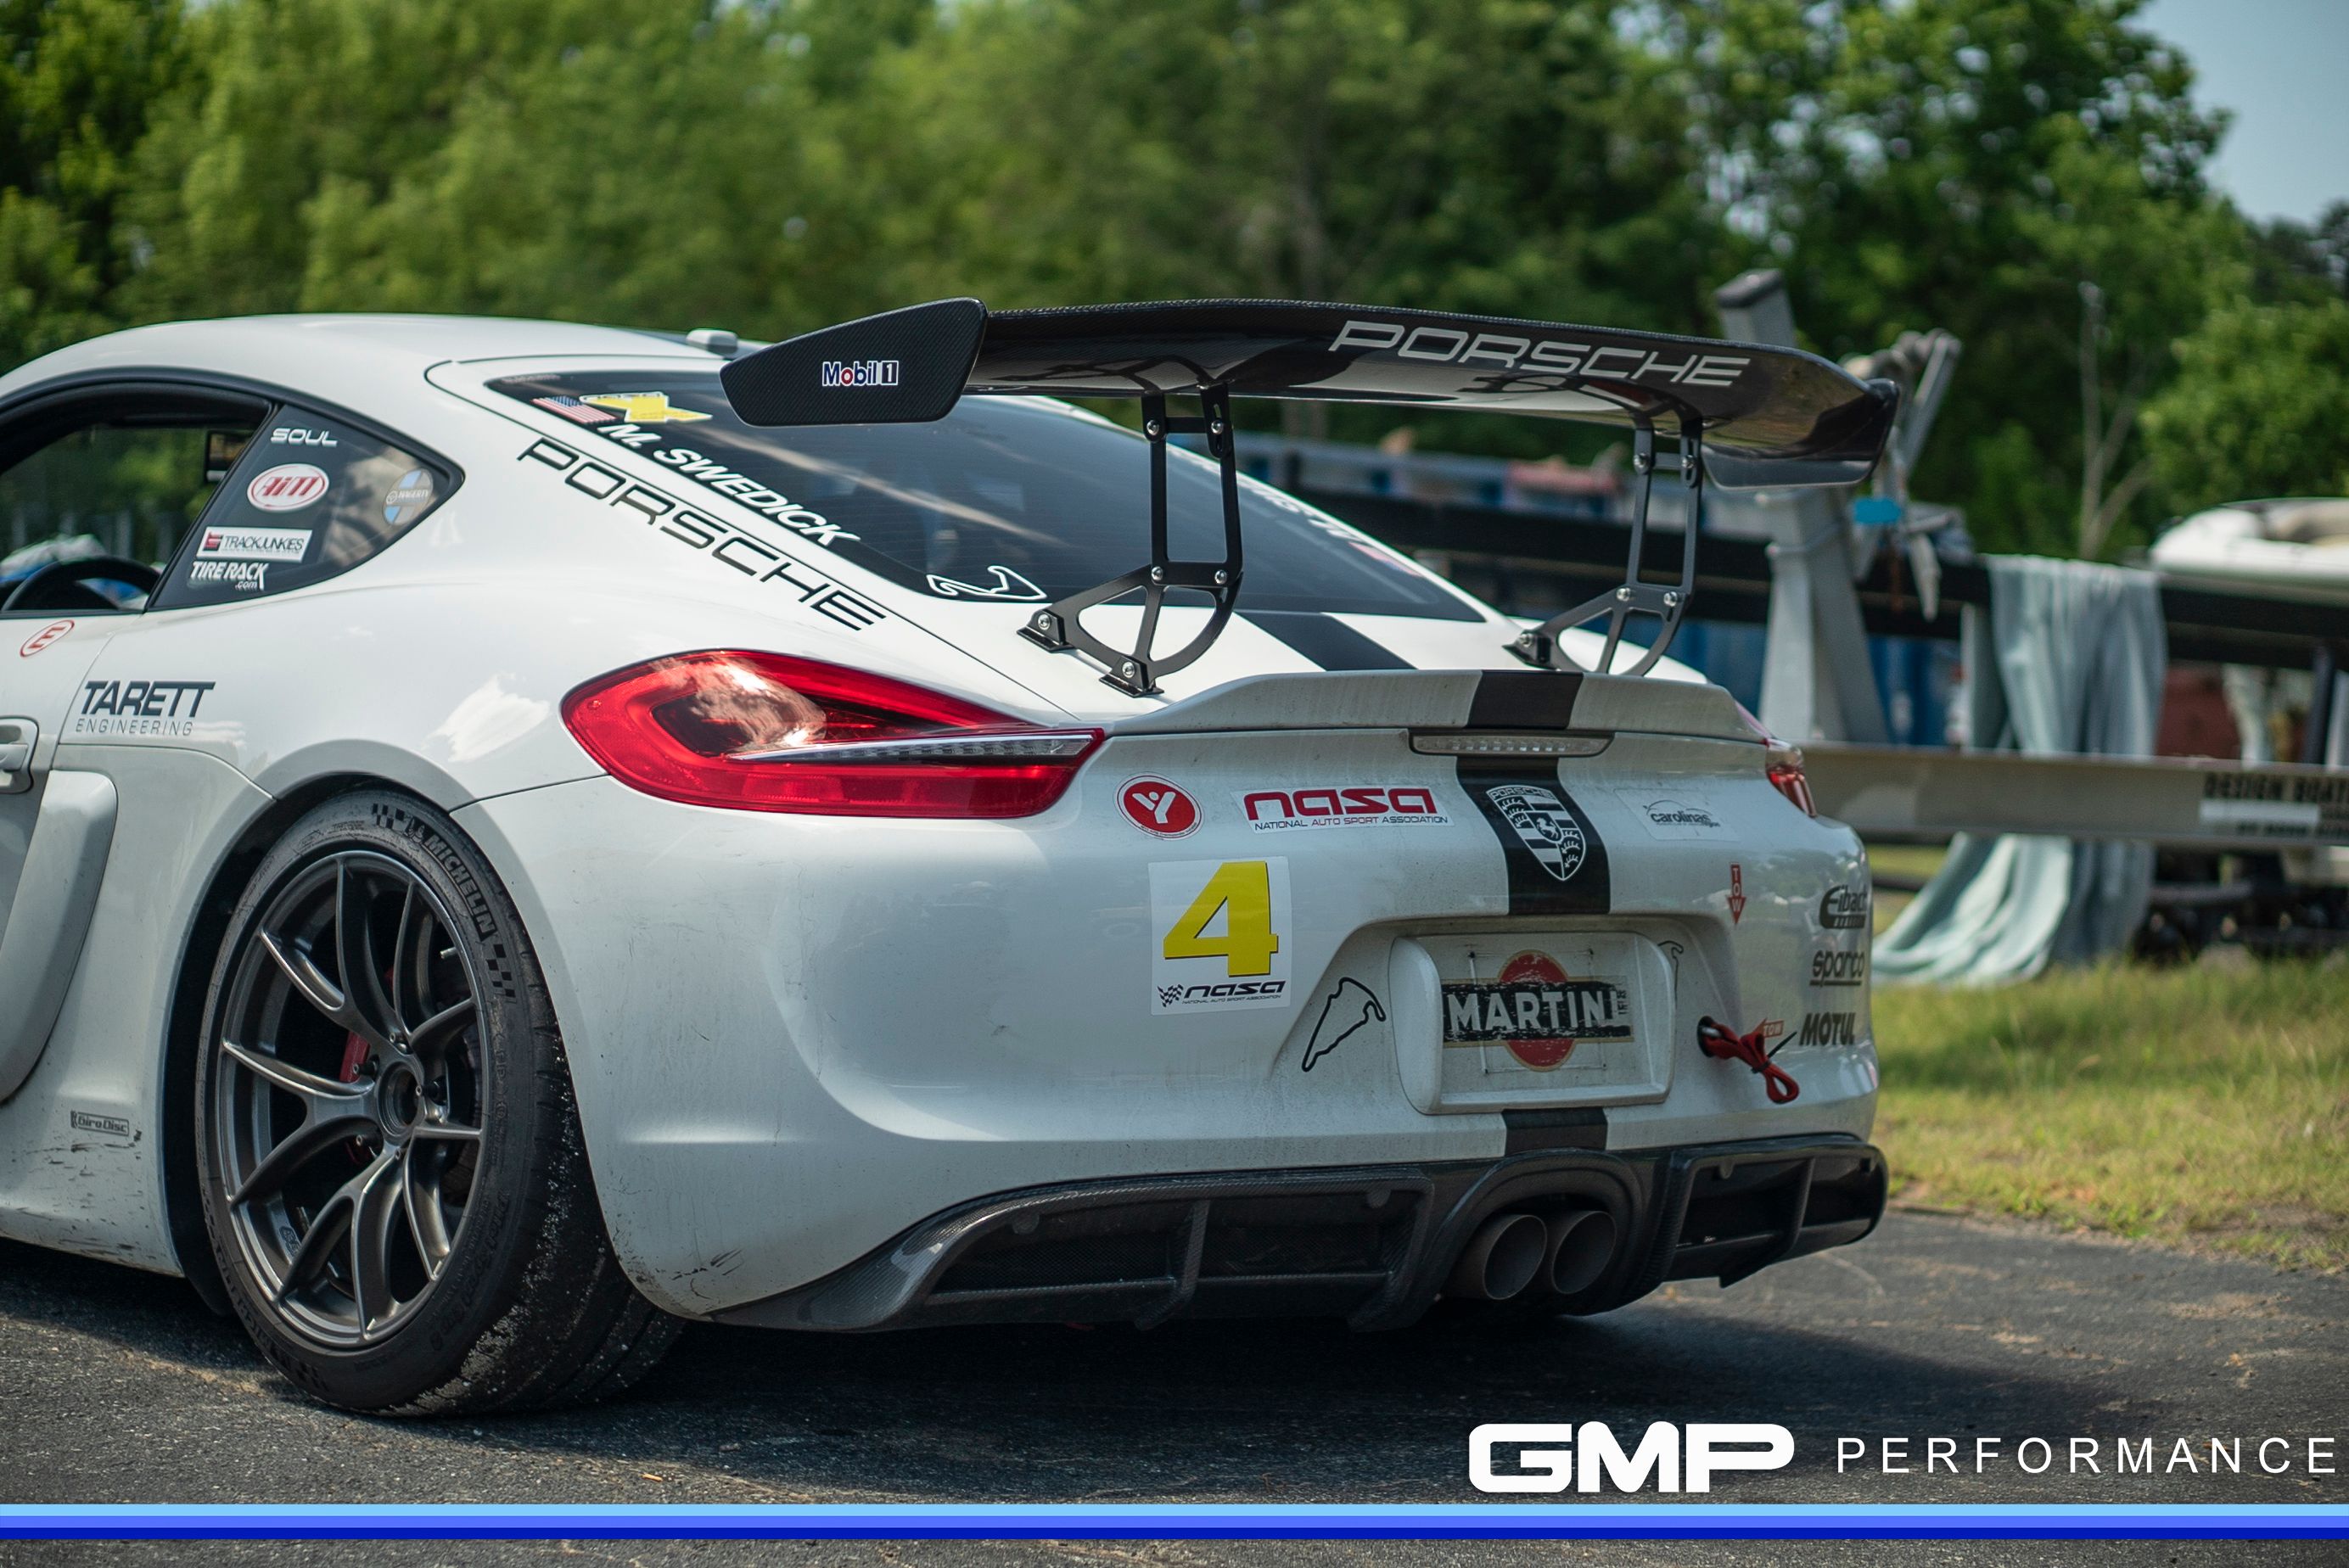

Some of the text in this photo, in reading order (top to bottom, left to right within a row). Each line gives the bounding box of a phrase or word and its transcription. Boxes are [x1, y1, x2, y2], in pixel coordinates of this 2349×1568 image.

[1328, 320, 1751, 386] PORSCHE
[822, 361, 877, 386] Mobil
[270, 428, 338, 445] SOUL
[597, 423, 861, 546] M. SWEDICK
[516, 437, 887, 631] PORSCHE
[190, 561, 269, 591] TIRE RACK
[27, 626, 66, 649] E
[81, 680, 216, 718] TARETT
[76, 719, 193, 736] ENGINEERING
[1243, 788, 1438, 820] nasa
[1490, 787, 1556, 800] PORSCHE
[1254, 815, 1448, 831] NATIONAL AUTO SPORT ASSOCIATION
[1651, 810, 1711, 823] carolinas
[424, 834, 496, 934] MICHELIN
[1732, 868, 1741, 913] TOW
[1163, 861, 1278, 977] 4
[1813, 950, 1864, 987] sparco
[1184, 980, 1287, 999] nasa
[1447, 990, 1619, 1033] MARTINI
[1763, 1024, 1783, 1036] TOW
[1799, 1012, 1856, 1046] MOTUL
